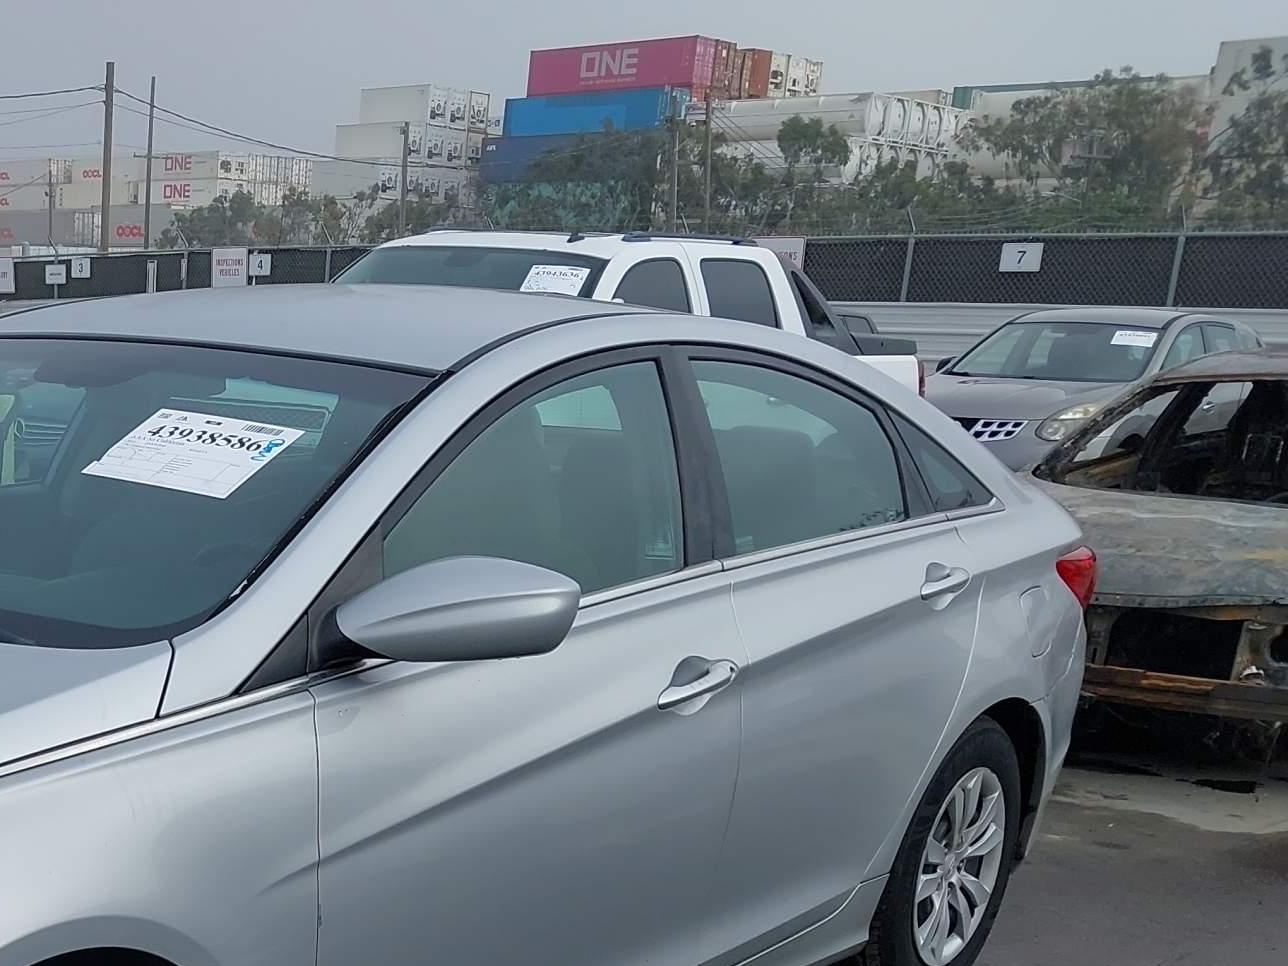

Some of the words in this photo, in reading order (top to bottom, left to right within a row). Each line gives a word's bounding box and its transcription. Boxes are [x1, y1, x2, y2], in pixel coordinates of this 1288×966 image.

[579, 48, 639, 78] ONE
[164, 155, 193, 171] ONE
[163, 183, 192, 199] ONE
[257, 259, 263, 271] 4
[1016, 250, 1028, 265] 7
[78, 262, 84, 273] 3
[147, 424, 267, 452] 43938586
